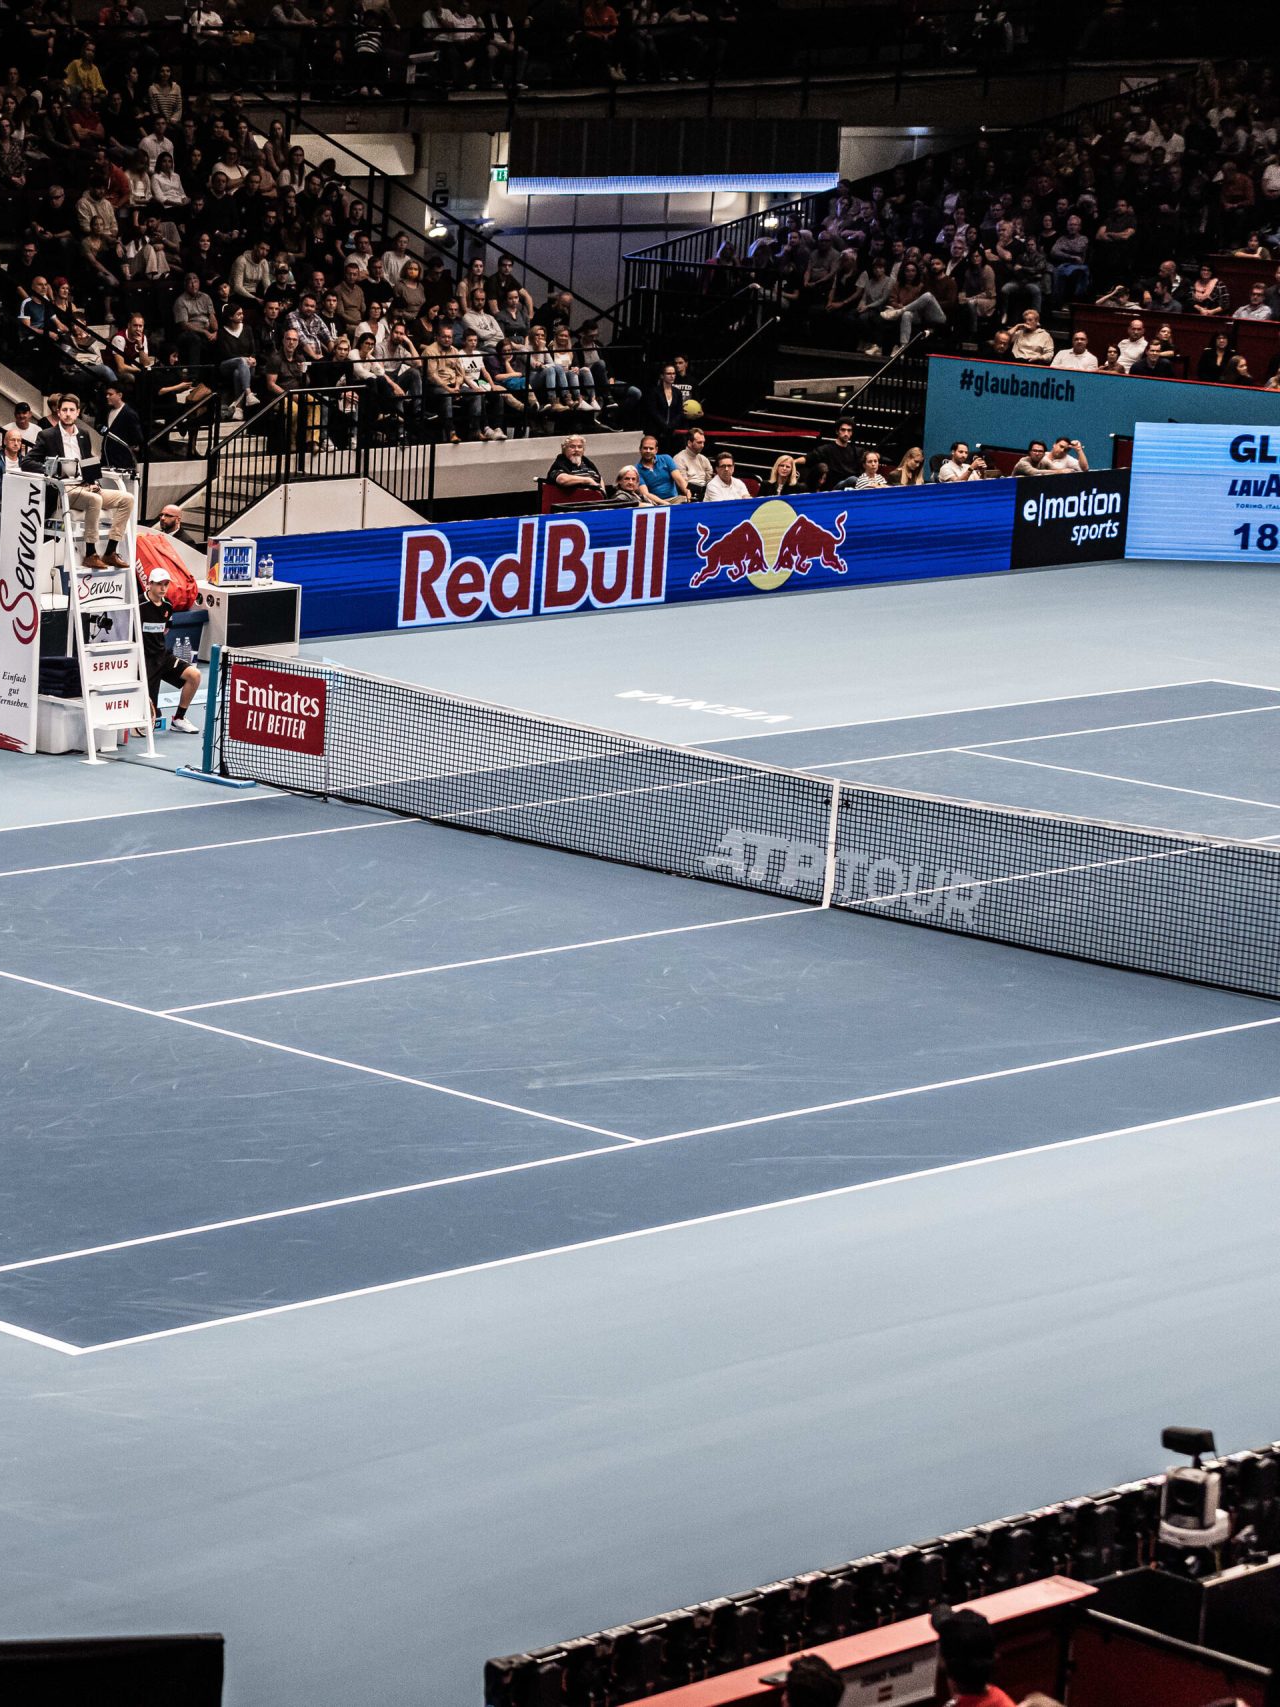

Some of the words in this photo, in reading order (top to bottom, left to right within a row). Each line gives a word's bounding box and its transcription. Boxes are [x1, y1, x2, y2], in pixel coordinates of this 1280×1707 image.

[960, 368, 1075, 402] #glaubandich
[1229, 434, 1280, 463] GL
[1070, 518, 1120, 546] sports
[400, 520, 537, 625] Red
[542, 509, 669, 610] Bull
[2, 671, 27, 684] Einfach
[92, 660, 129, 672] SERVUS
[8, 687, 19, 697] gut
[105, 699, 129, 710] WIEN
[235, 678, 320, 718] Emirates
[616, 689, 793, 724] VIENNA
[246, 710, 266, 732] FLY
[266, 713, 307, 740] BETTER
[837, 848, 984, 928] TOUR
